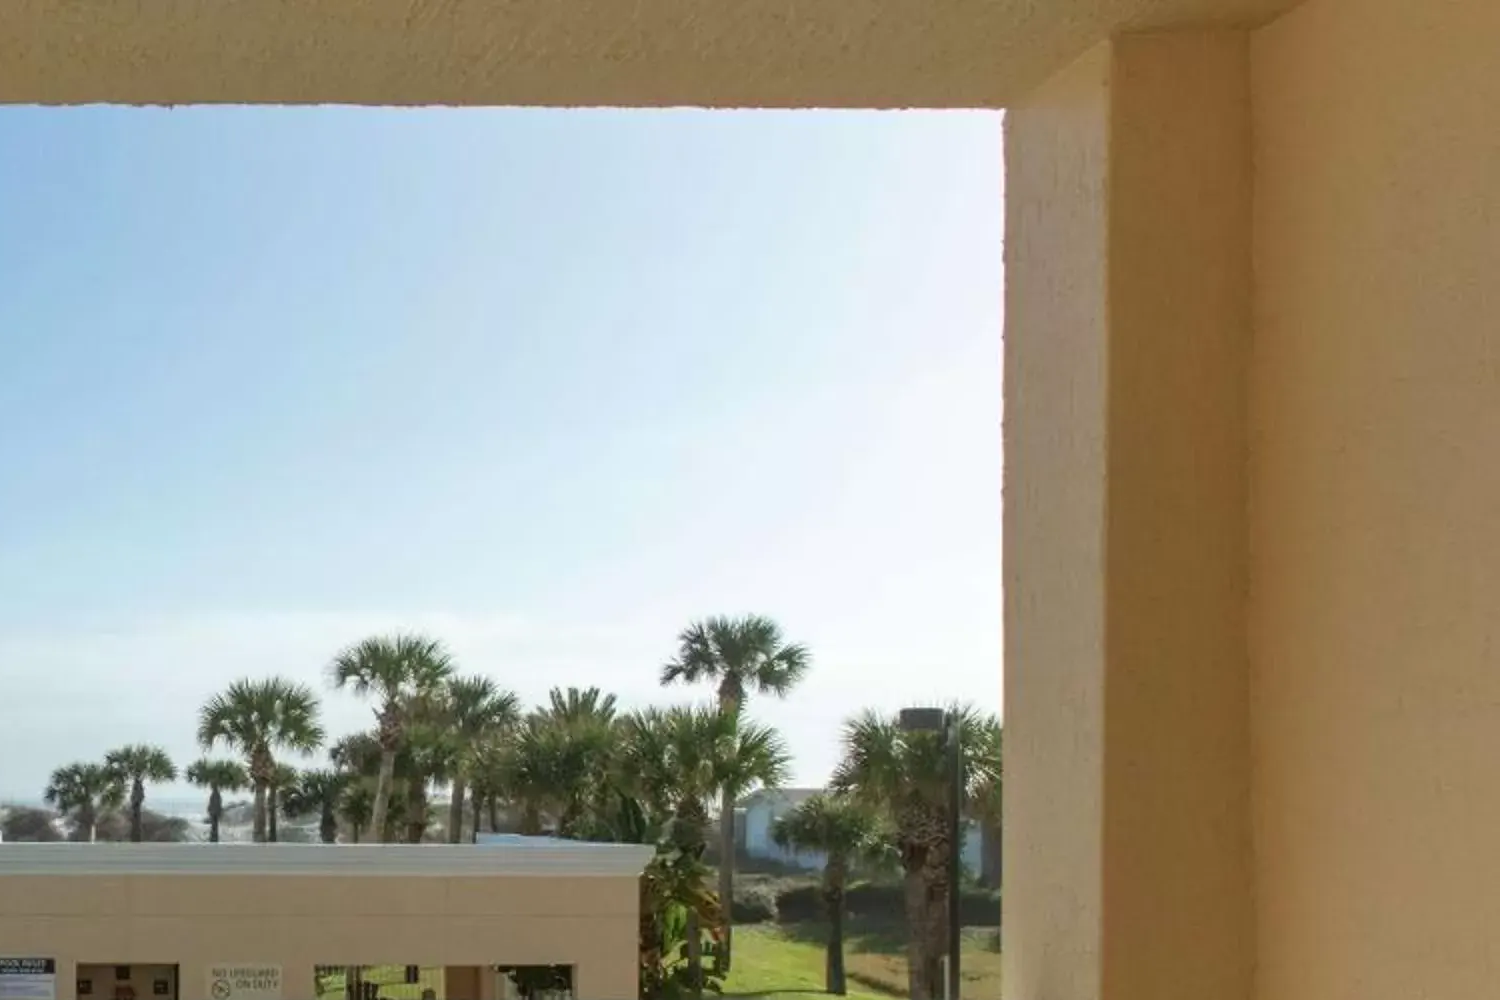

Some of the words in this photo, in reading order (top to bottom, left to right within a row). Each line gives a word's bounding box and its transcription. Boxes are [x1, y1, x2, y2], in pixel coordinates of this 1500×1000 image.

[212, 967, 227, 977] NO
[235, 979, 250, 989] ON
[252, 979, 278, 990] DUTY
